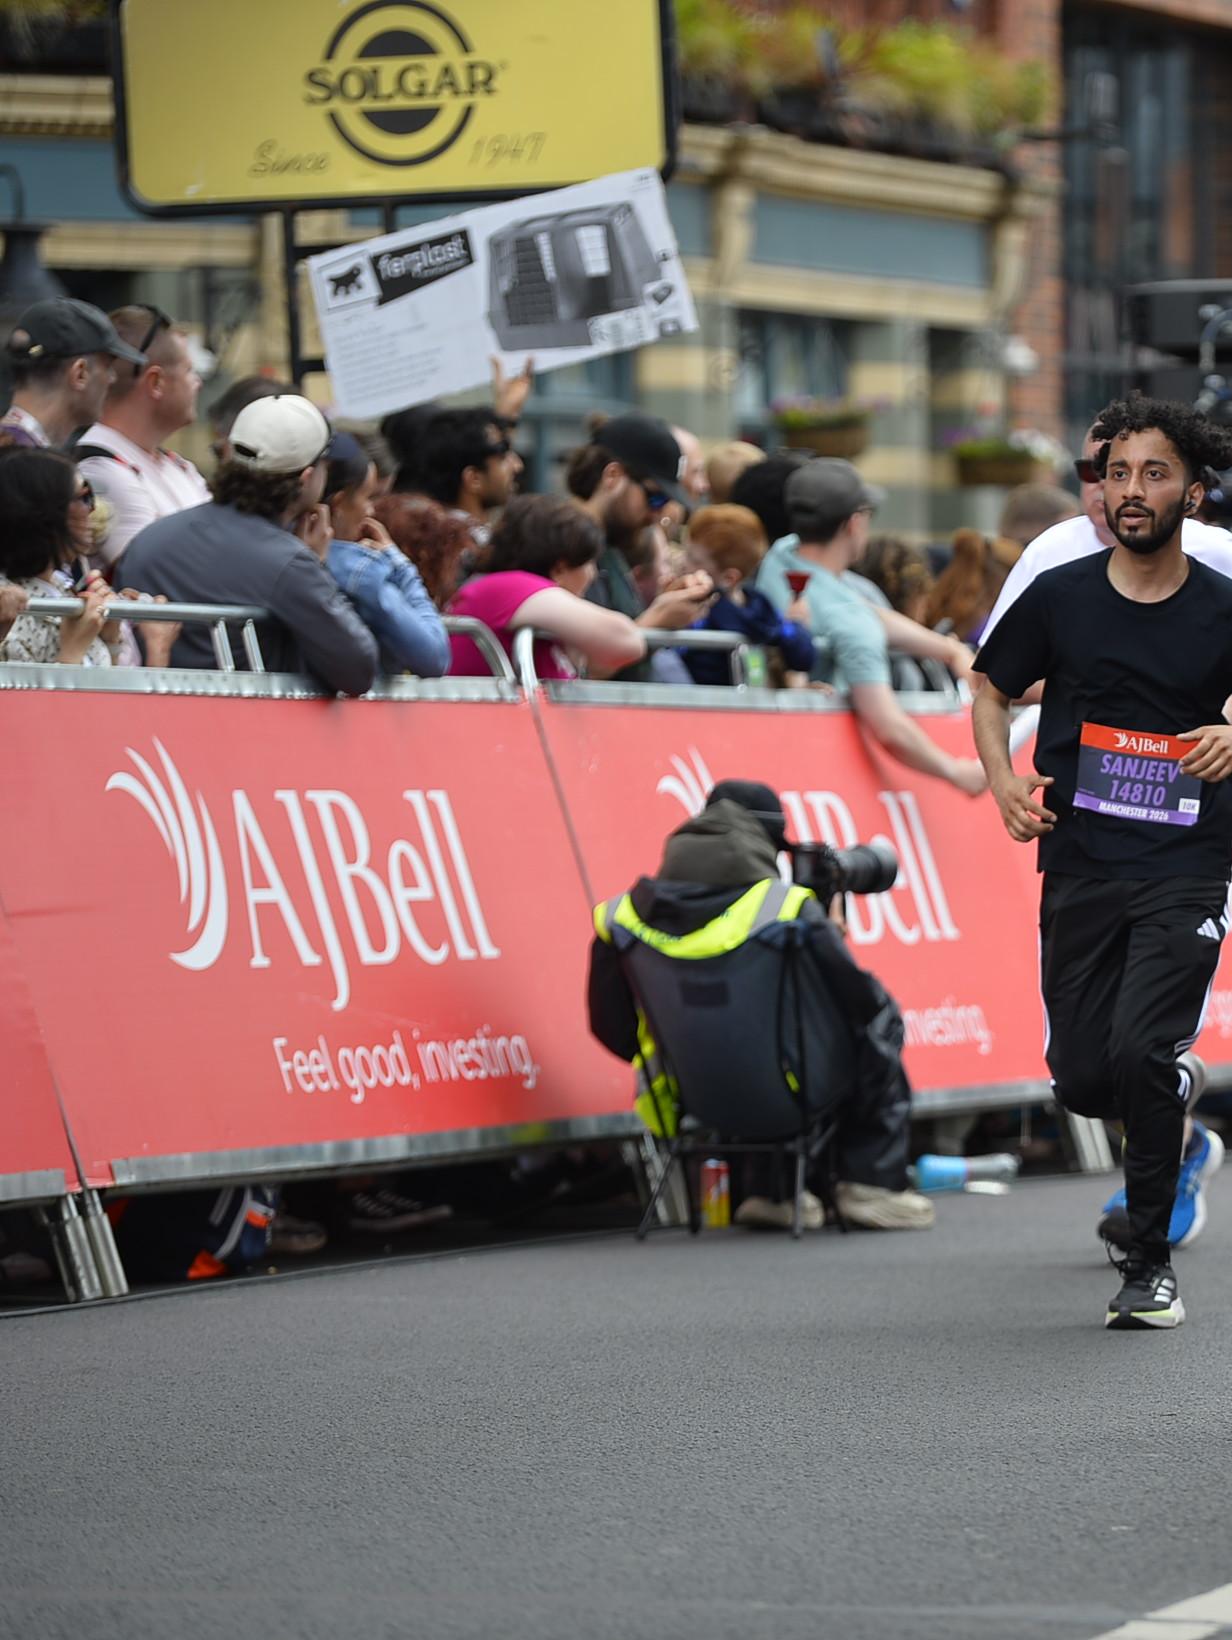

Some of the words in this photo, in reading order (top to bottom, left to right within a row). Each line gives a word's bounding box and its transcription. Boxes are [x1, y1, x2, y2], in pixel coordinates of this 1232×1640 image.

[302, 61, 498, 105] SOLGAR
[1126, 736, 1168, 754] AJBell
[1100, 753, 1181, 783] SANJEEV
[1109, 779, 1167, 807] 14810
[1098, 800, 1148, 819] MANCHESTER
[1148, 809, 1169, 821] 2026
[231, 788, 502, 1011] AJBell
[272, 1034, 340, 1093] Feel
[337, 1029, 421, 1104] good,
[412, 1023, 541, 1090] investing.
